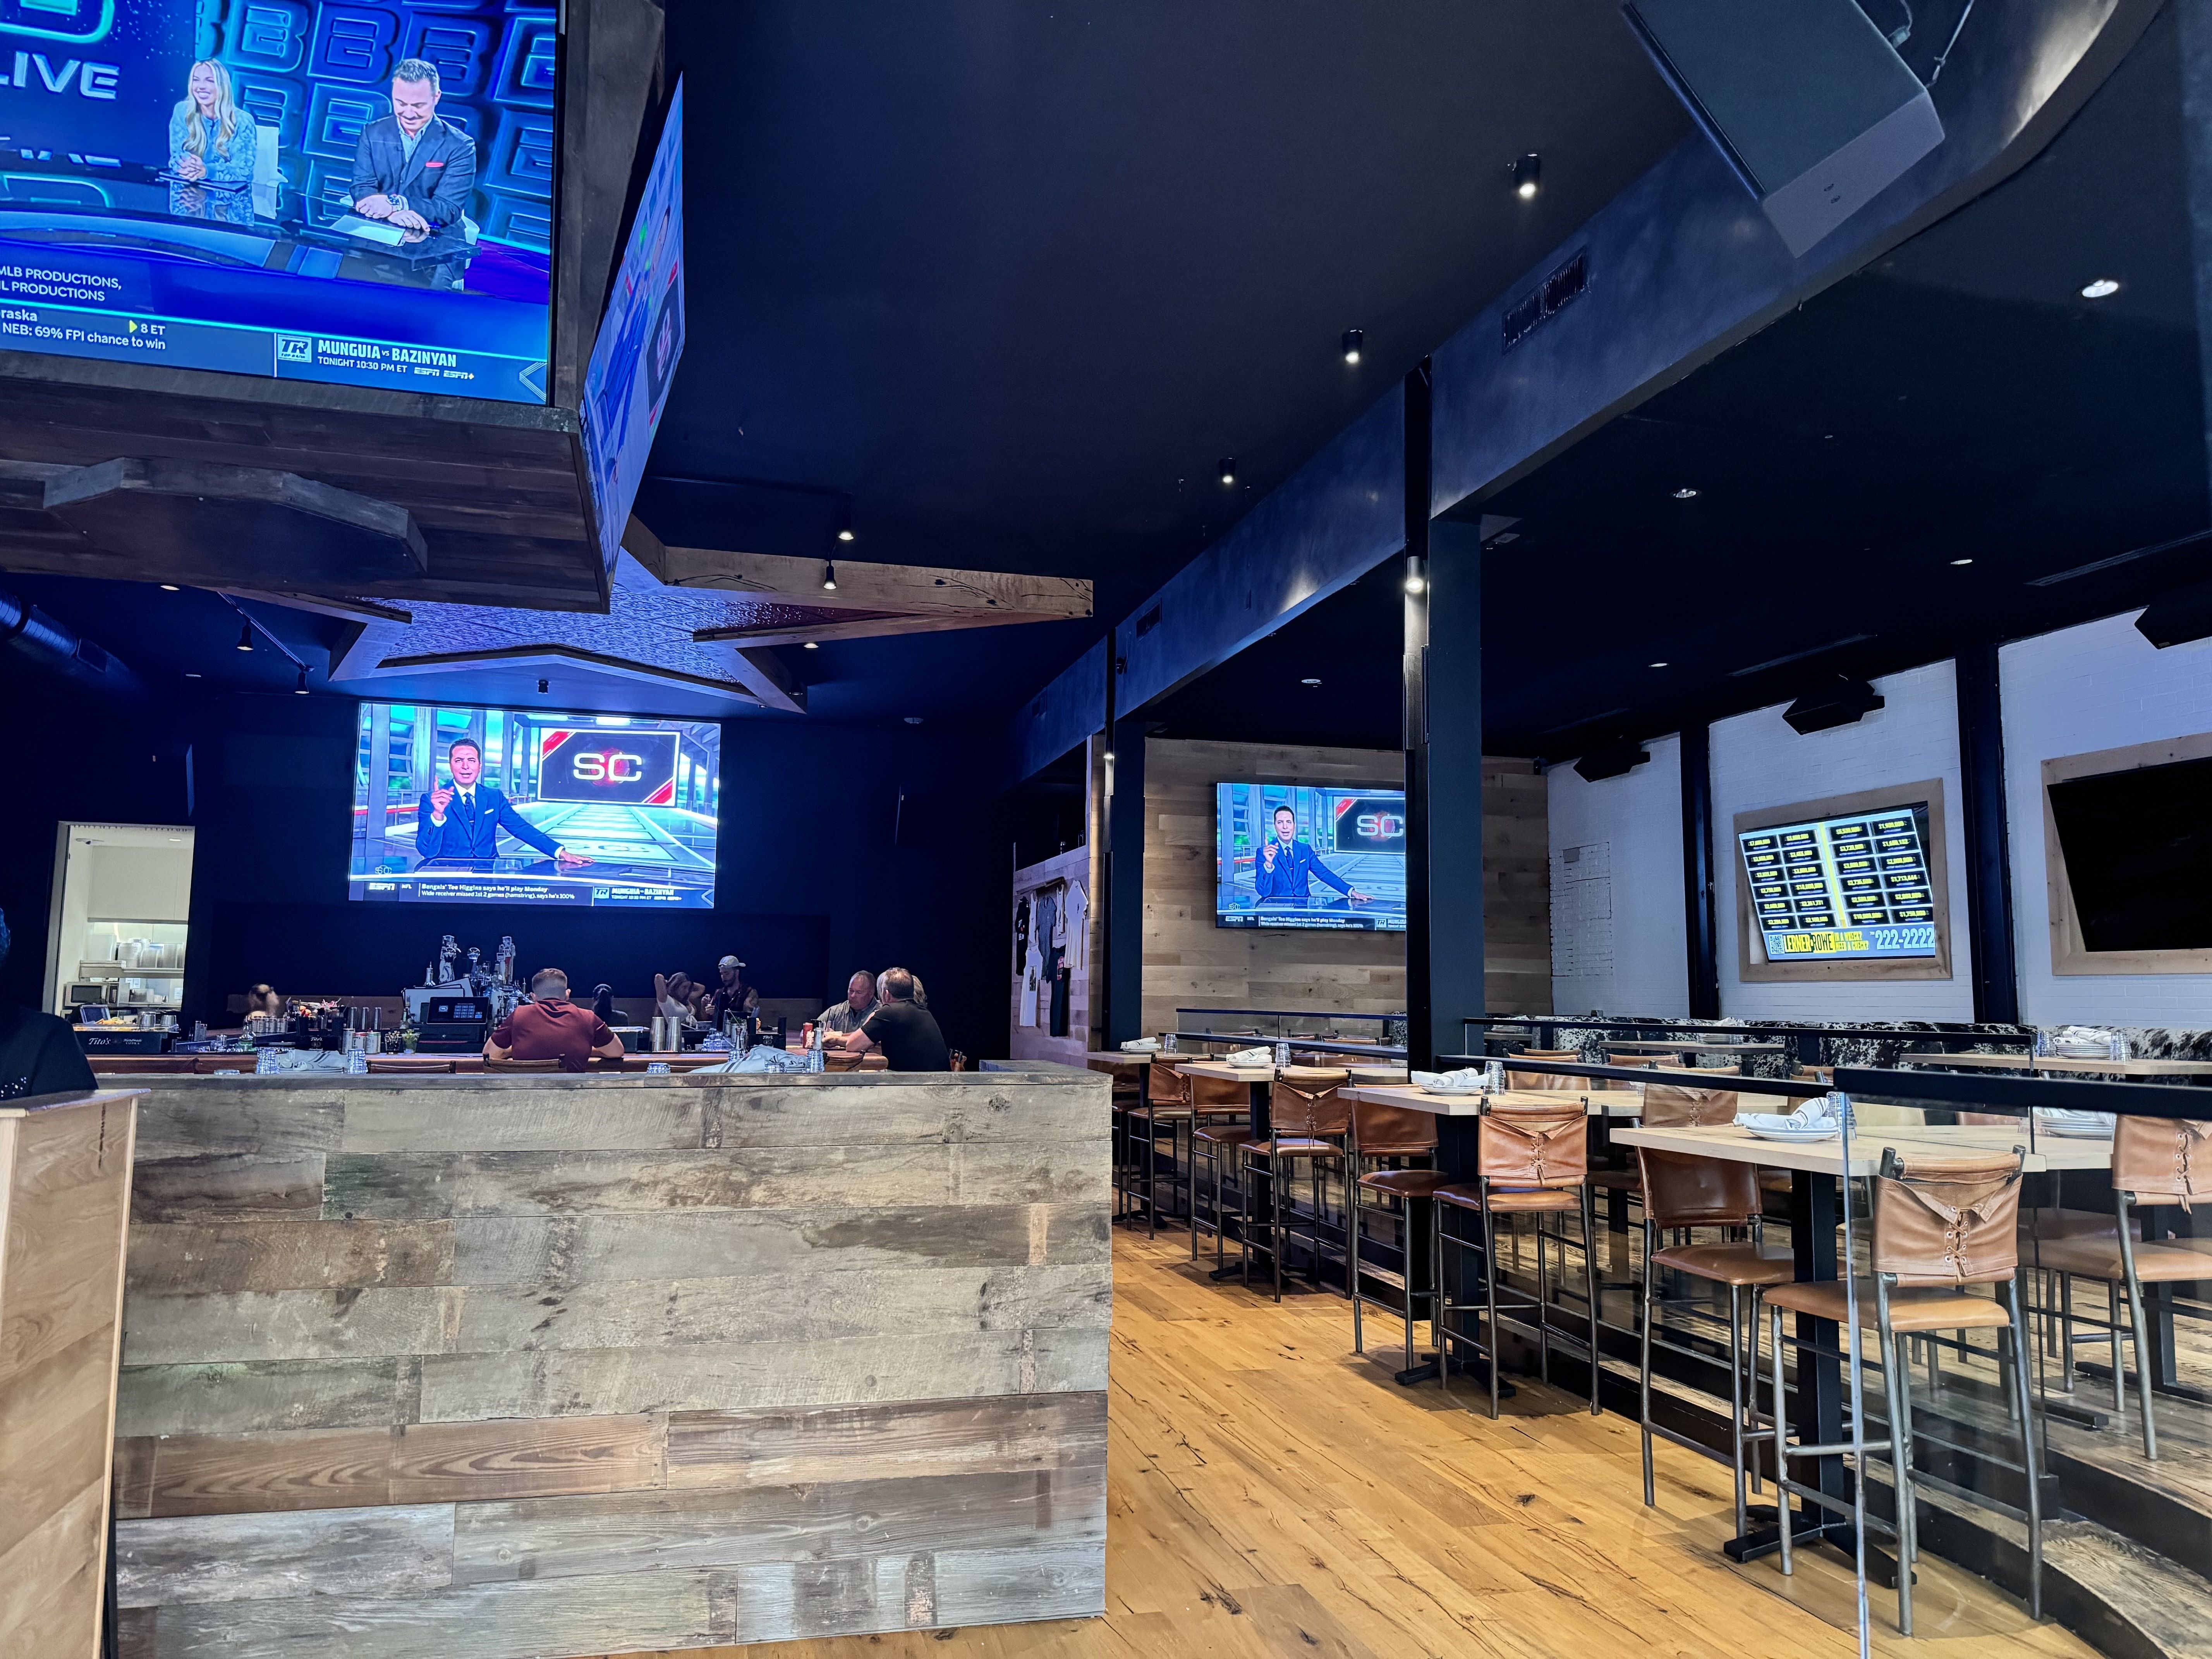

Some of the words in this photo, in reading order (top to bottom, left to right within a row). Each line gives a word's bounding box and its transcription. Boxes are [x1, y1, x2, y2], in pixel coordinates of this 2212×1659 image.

[26, 268, 122, 290] PRODUCTIONS,
[12, 282, 105, 302] PRODUCTIONS
[3, 323, 32, 336] NEB:
[35, 326, 63, 339] 69%
[65, 329, 84, 342] FPI
[87, 332, 129, 346] chance
[131, 336, 144, 347] to
[145, 338, 166, 350] win
[141, 323, 148, 333] 8
[151, 325, 165, 335] ET
[318, 340, 381, 359] MUNGUIA
[392, 348, 456, 367] BAZINYAN
[318, 356, 354, 368] TONIGHT
[356, 360, 378, 370] 10:30
[381, 362, 395, 372] PM
[397, 365, 407, 373] ET
[414, 367, 440, 376] ESPN
[573, 752, 642, 782] SC
[1357, 815, 1403, 837] SC
[1783, 934, 1812, 952] LERNER
[1813, 934, 1833, 951] ROWE
[1875, 927, 1935, 950] 222-2222
